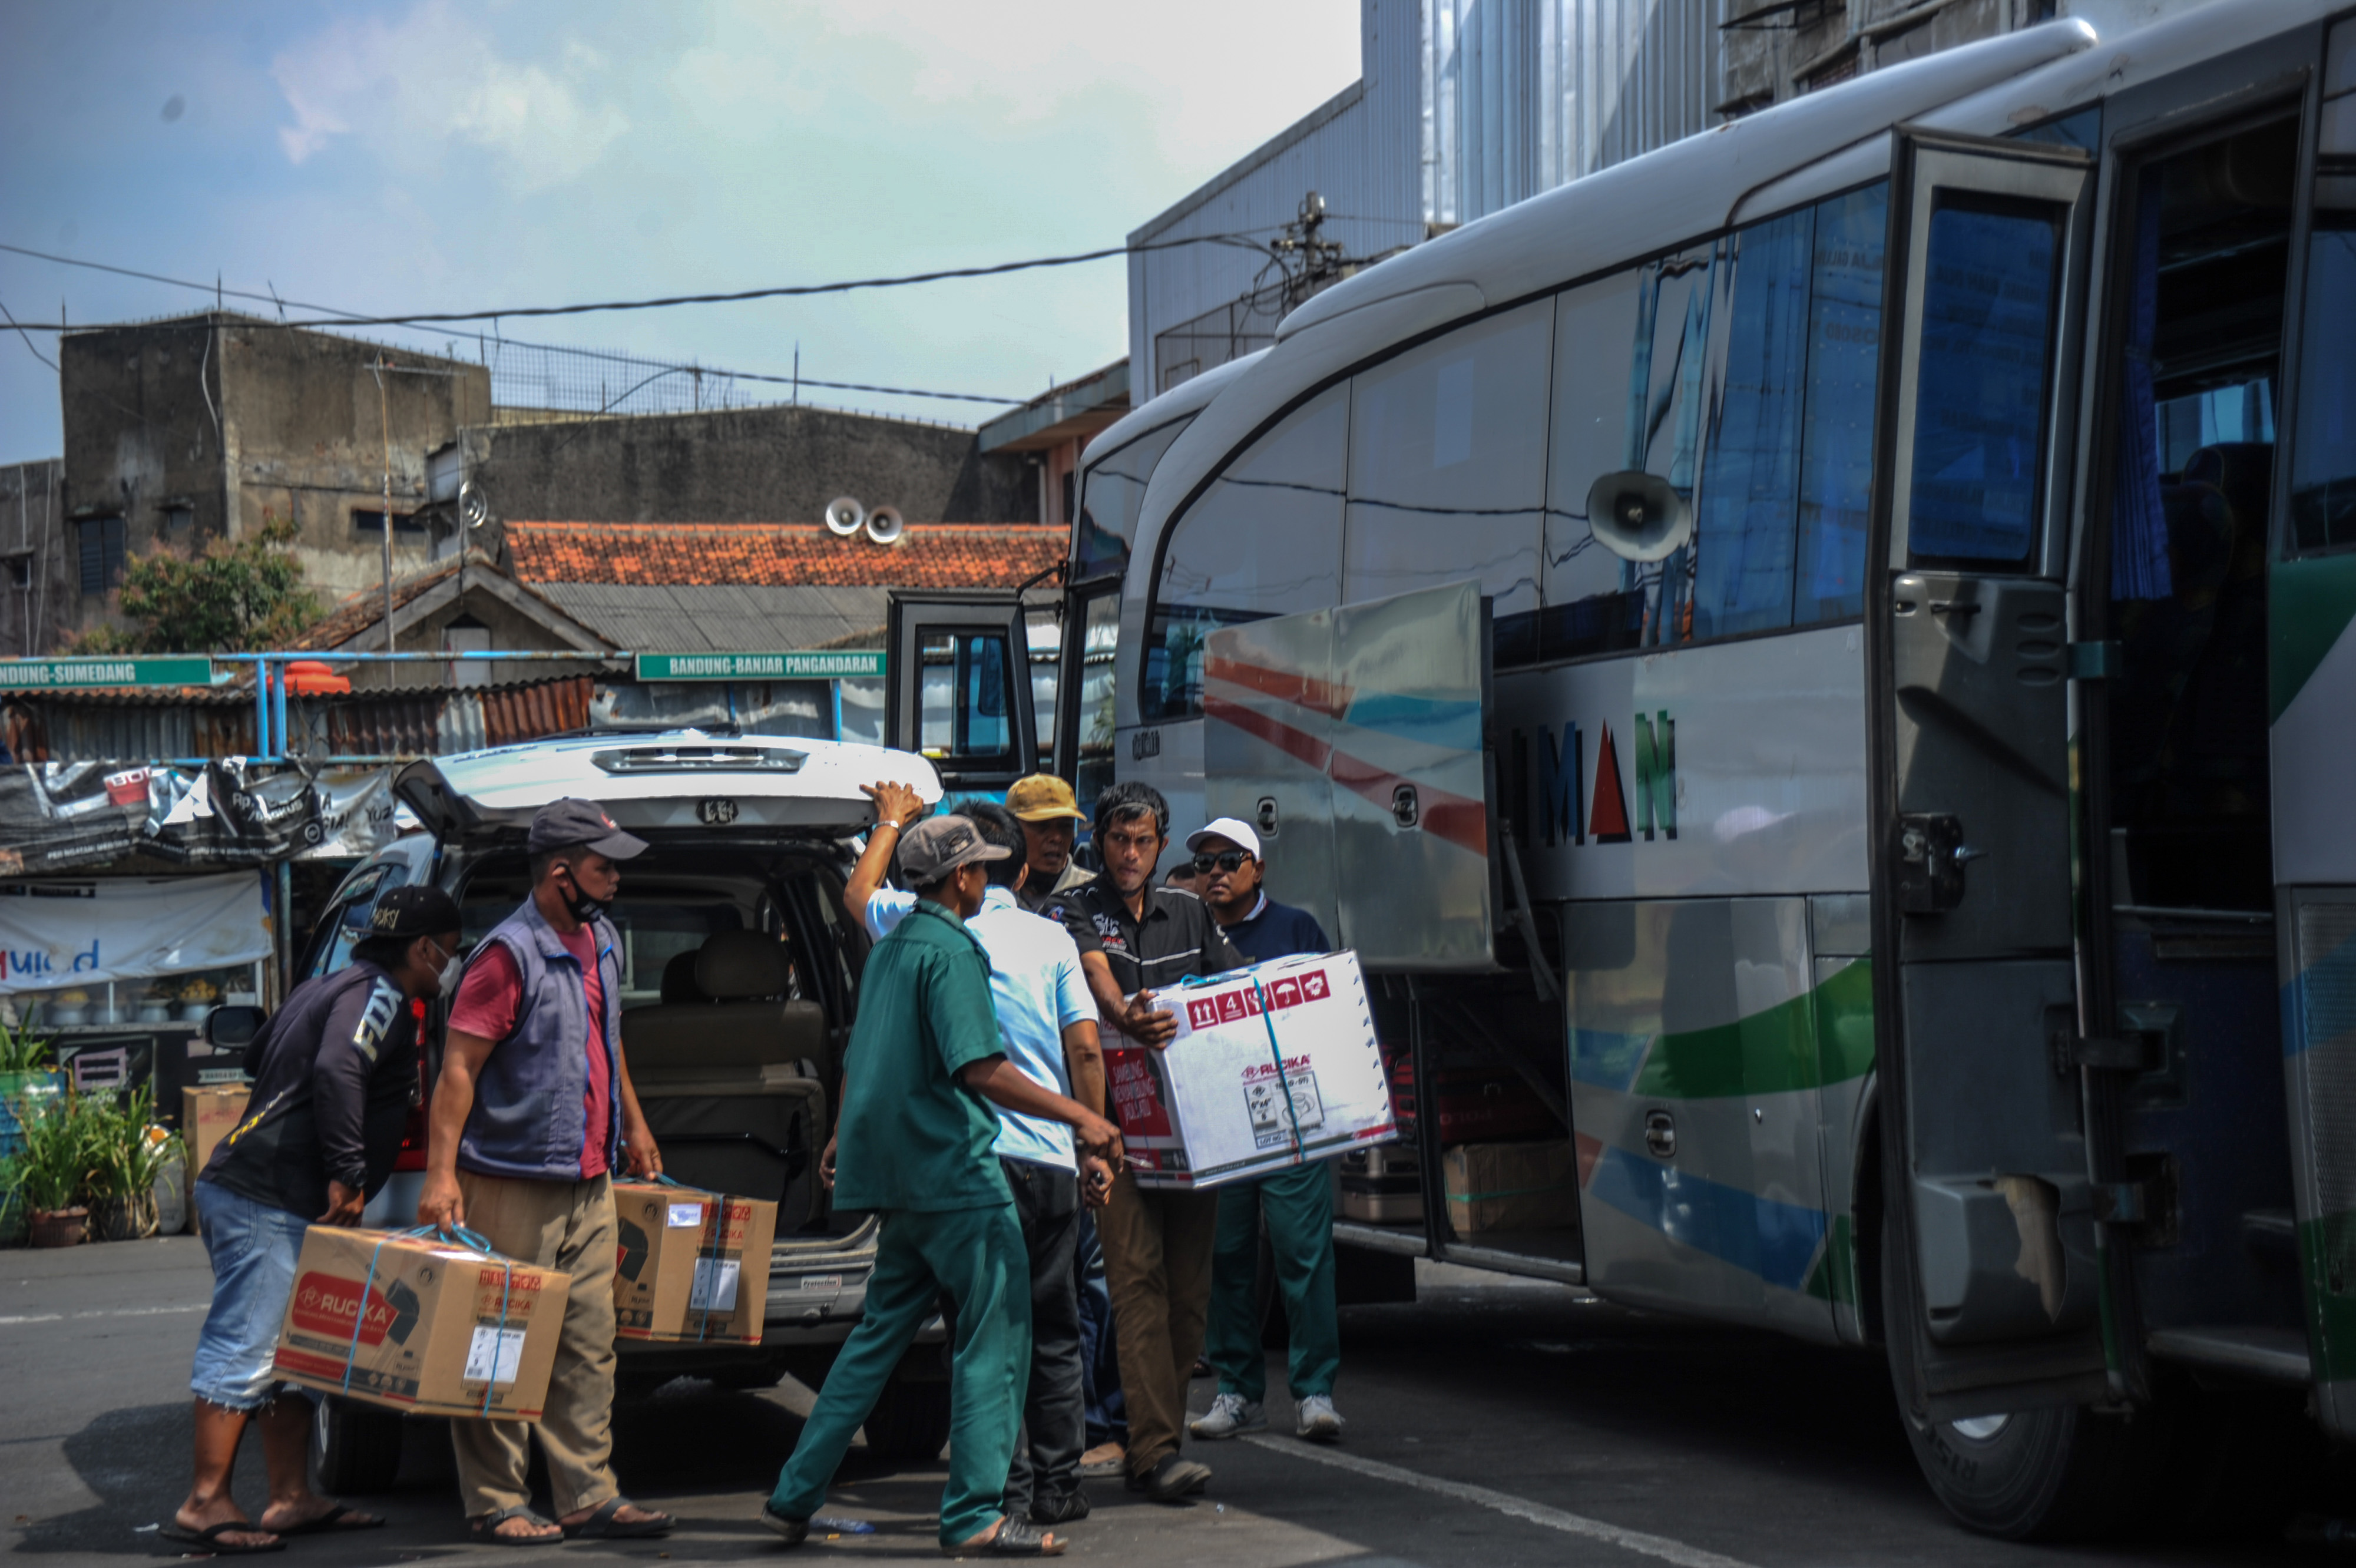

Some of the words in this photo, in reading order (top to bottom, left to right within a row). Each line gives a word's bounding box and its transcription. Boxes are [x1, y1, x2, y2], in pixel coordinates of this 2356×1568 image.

[670, 656, 783, 676] BANDUNG-BANJAR
[786, 655, 877, 673] PANGANDARAN
[353, 975, 403, 1062] FOX
[803, 1279, 837, 1288] Protection
[320, 1294, 387, 1325] RUCKA
